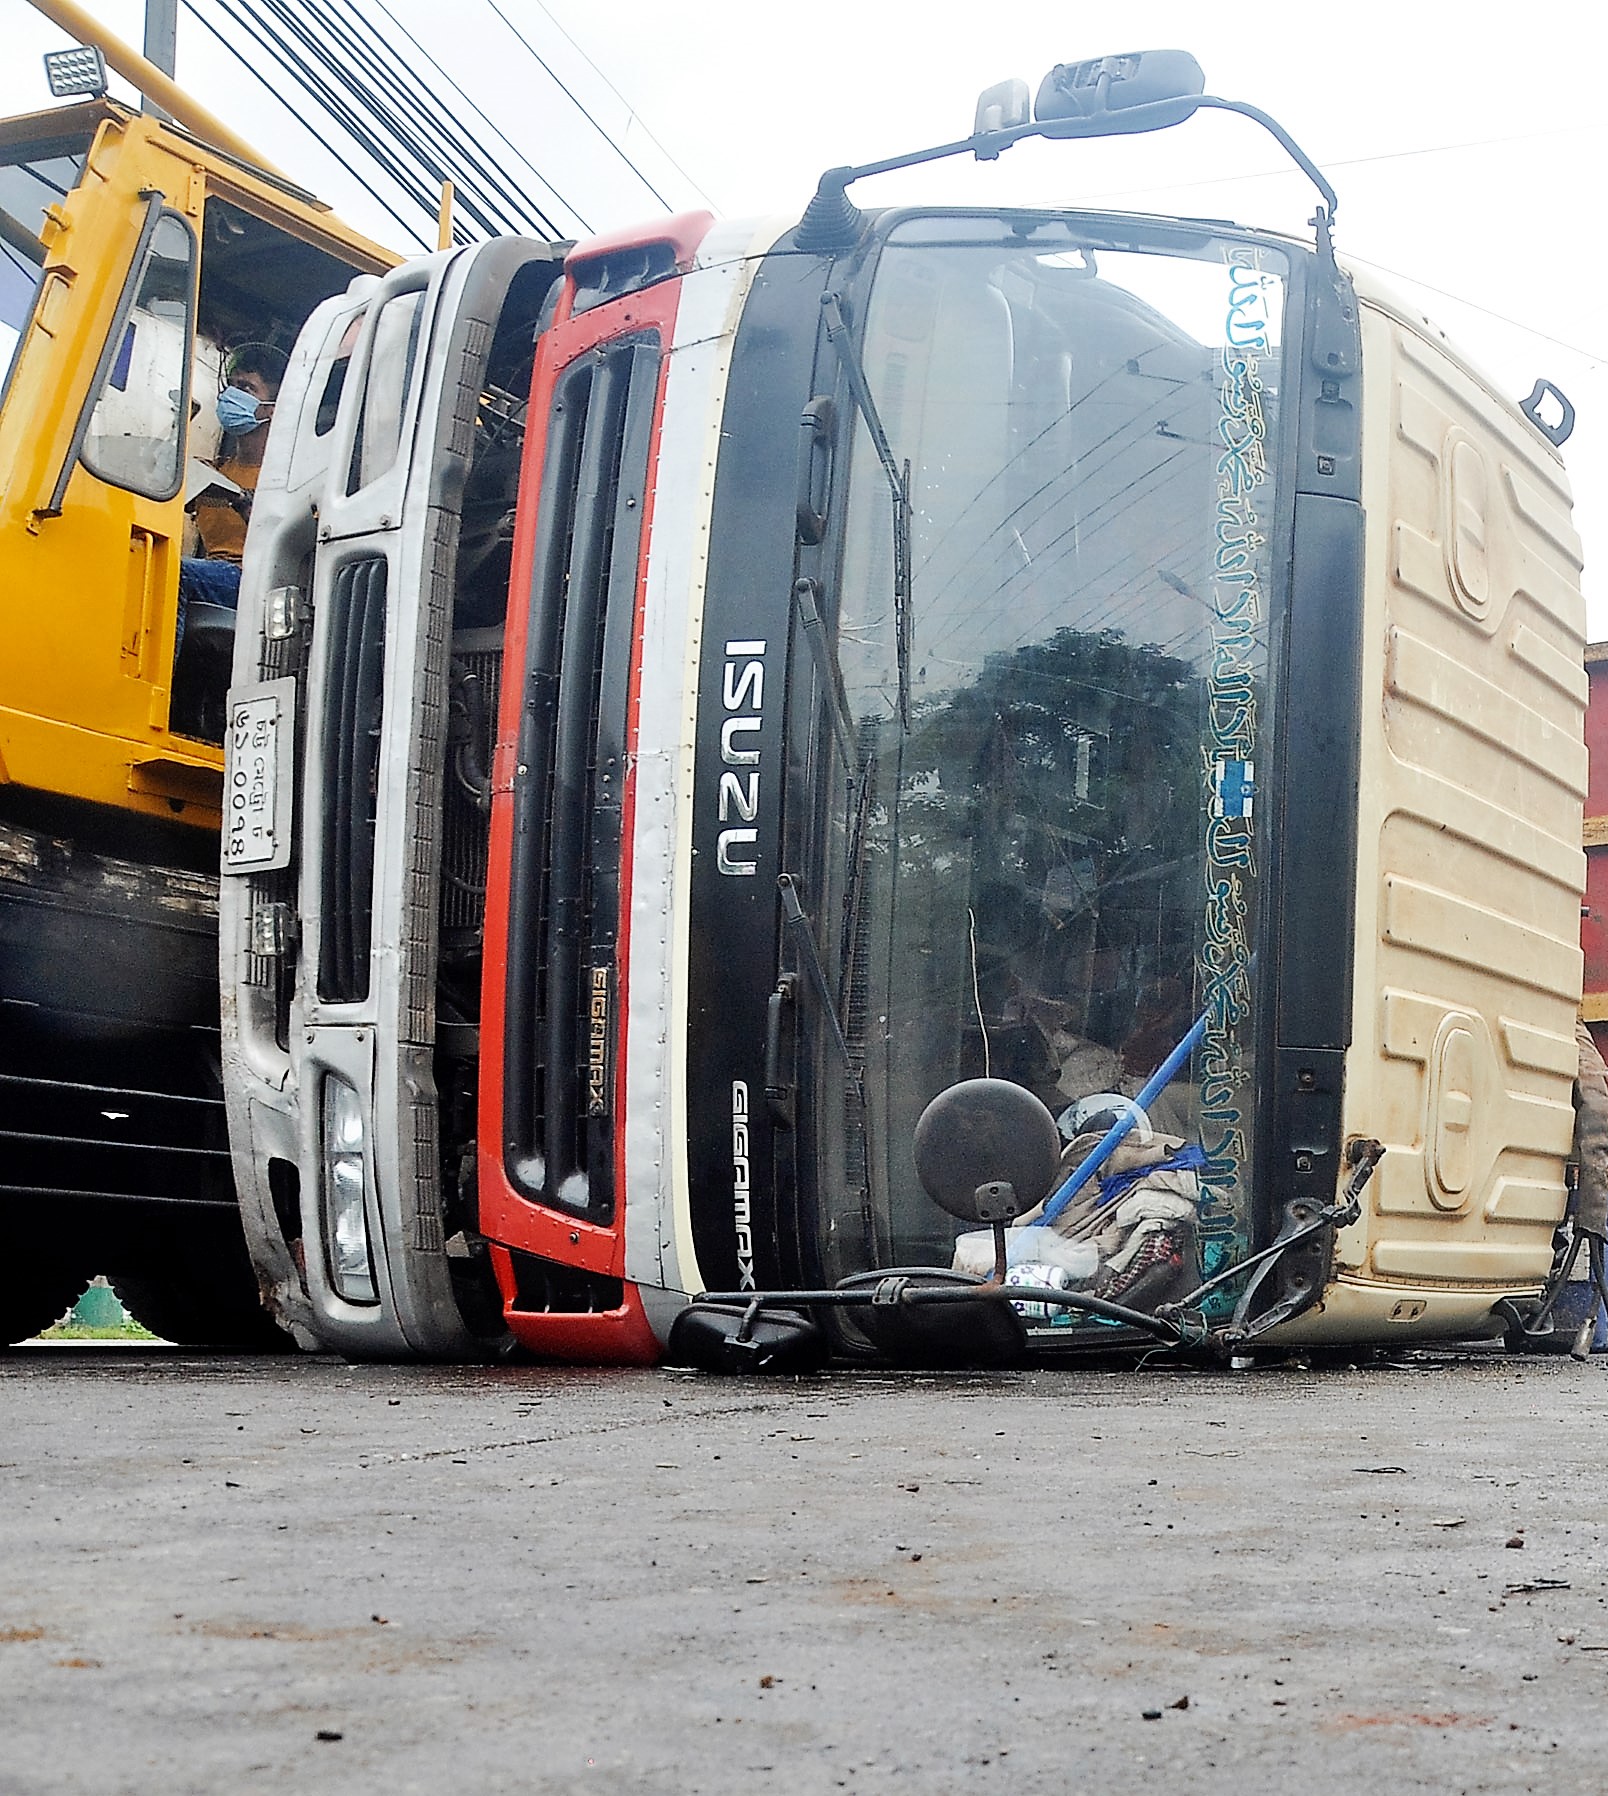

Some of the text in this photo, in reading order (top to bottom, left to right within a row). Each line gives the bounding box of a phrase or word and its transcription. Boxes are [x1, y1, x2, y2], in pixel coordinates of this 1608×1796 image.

[715, 639, 766, 877] ISUZU
[587, 967, 608, 1111] GIGAMAX
[730, 1080, 755, 1292] GIGAMAX
